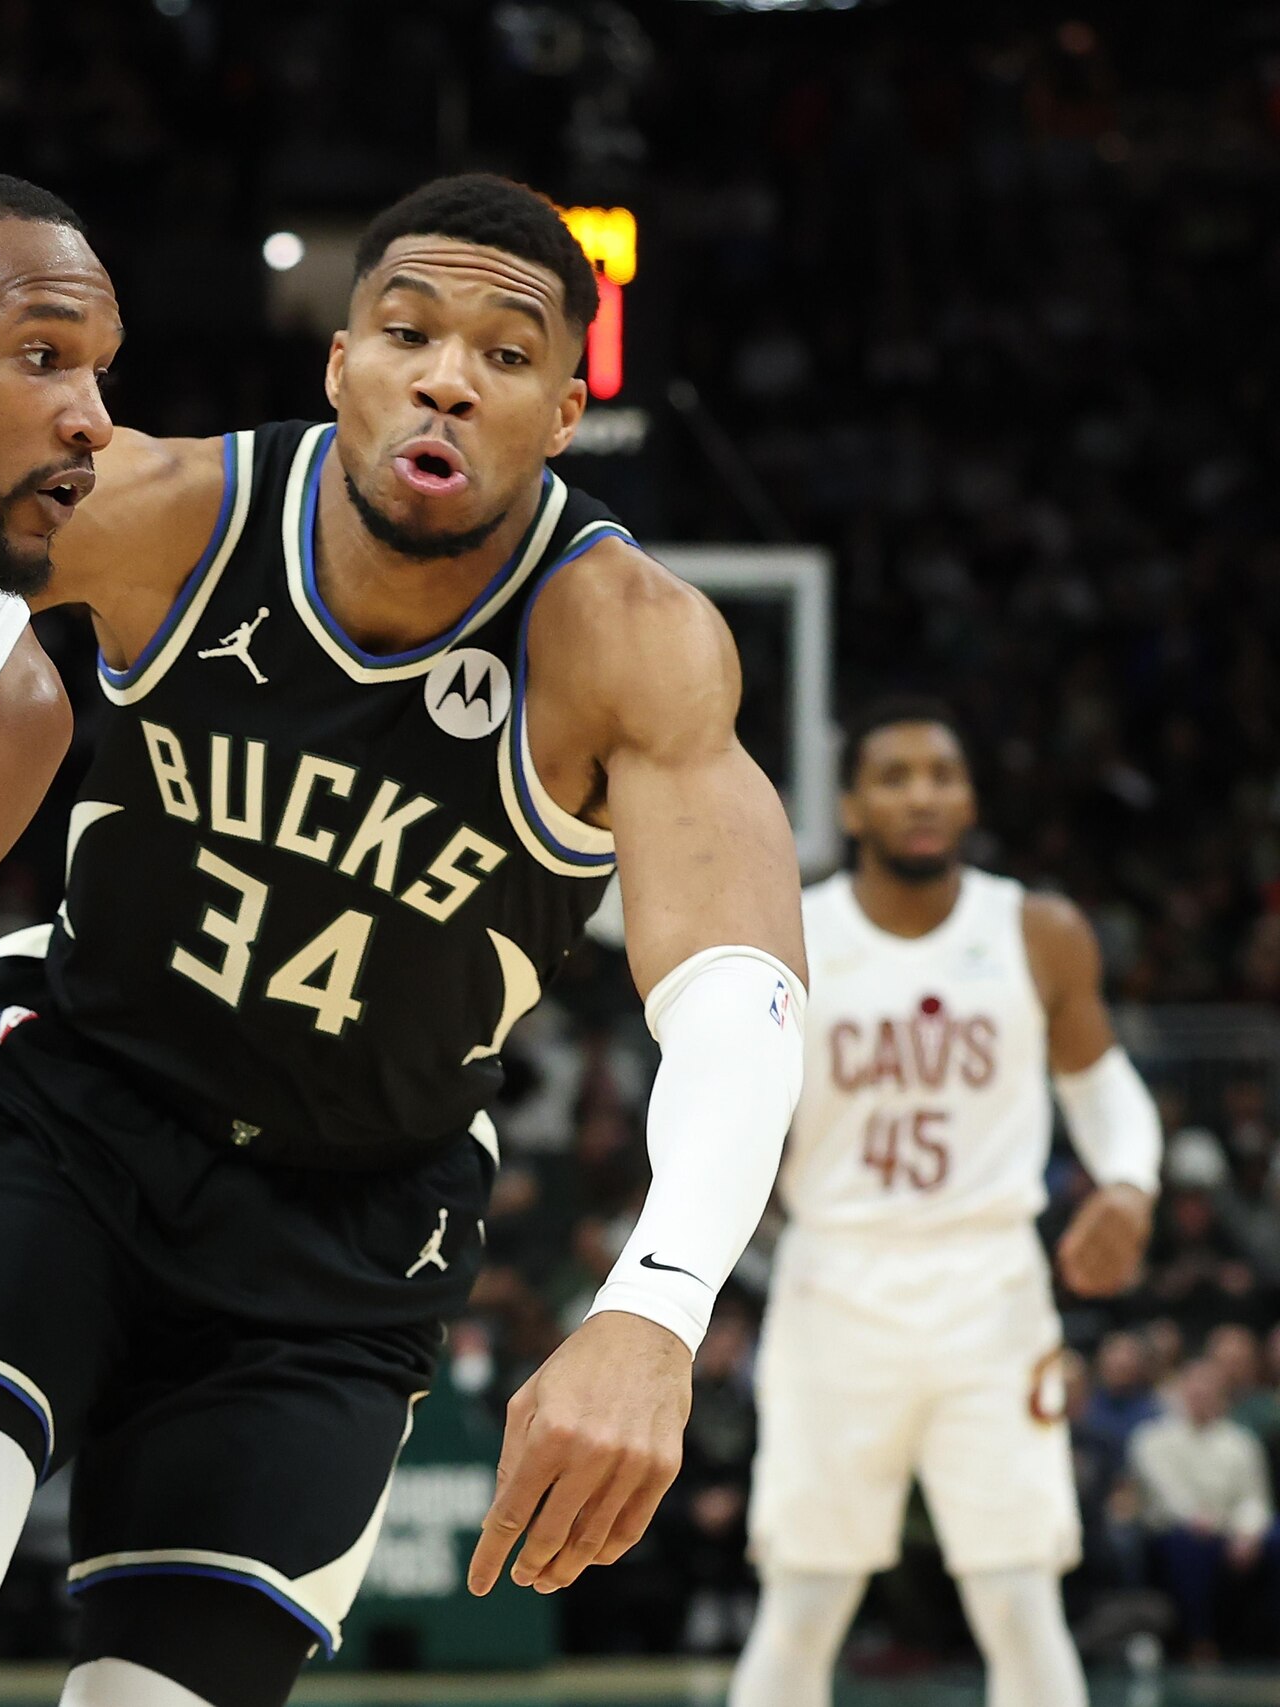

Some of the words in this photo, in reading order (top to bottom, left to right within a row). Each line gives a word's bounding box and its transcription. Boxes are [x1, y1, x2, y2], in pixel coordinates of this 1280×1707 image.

[140, 717, 511, 924] BUCKS
[170, 845, 376, 1037] 34
[828, 1000, 1000, 1092] CAVS
[862, 1110, 950, 1192] 45
